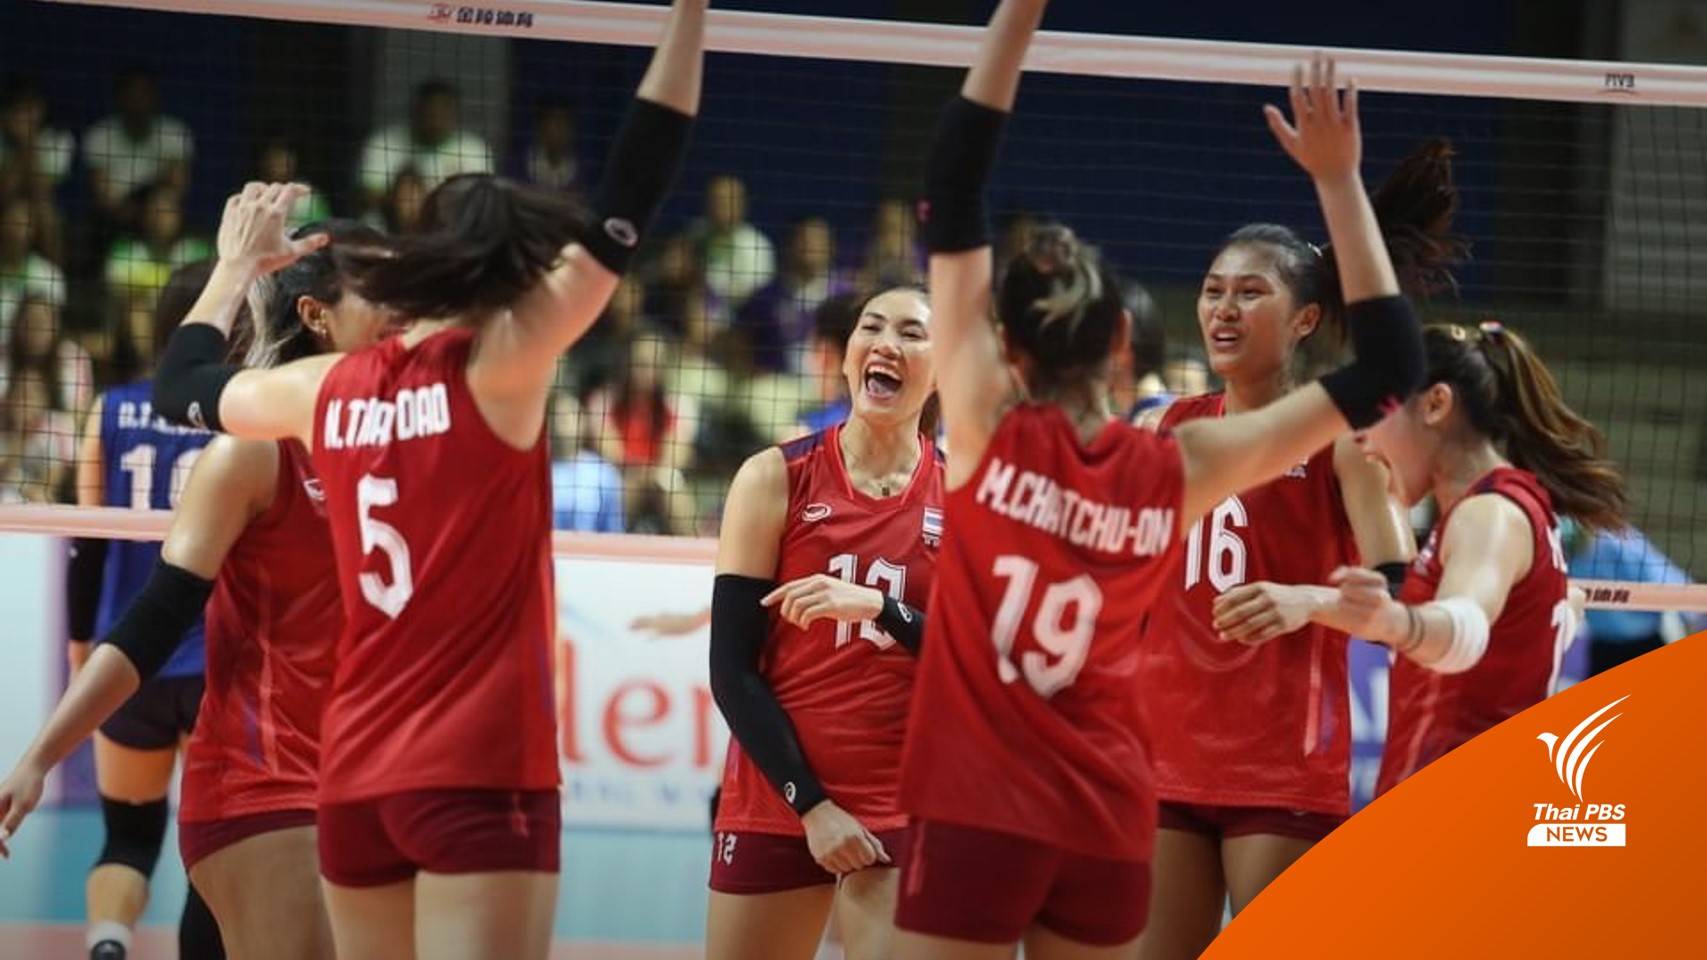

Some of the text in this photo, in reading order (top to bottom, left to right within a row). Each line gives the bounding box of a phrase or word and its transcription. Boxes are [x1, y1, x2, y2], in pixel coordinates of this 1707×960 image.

[1605, 72, 1635, 88] FIVB
[357, 473, 413, 620] 5
[976, 457, 1175, 557] M.CHATCHU-ON
[1185, 493, 1248, 593] 16
[991, 554, 1104, 698] 19
[717, 831, 737, 866] 12
